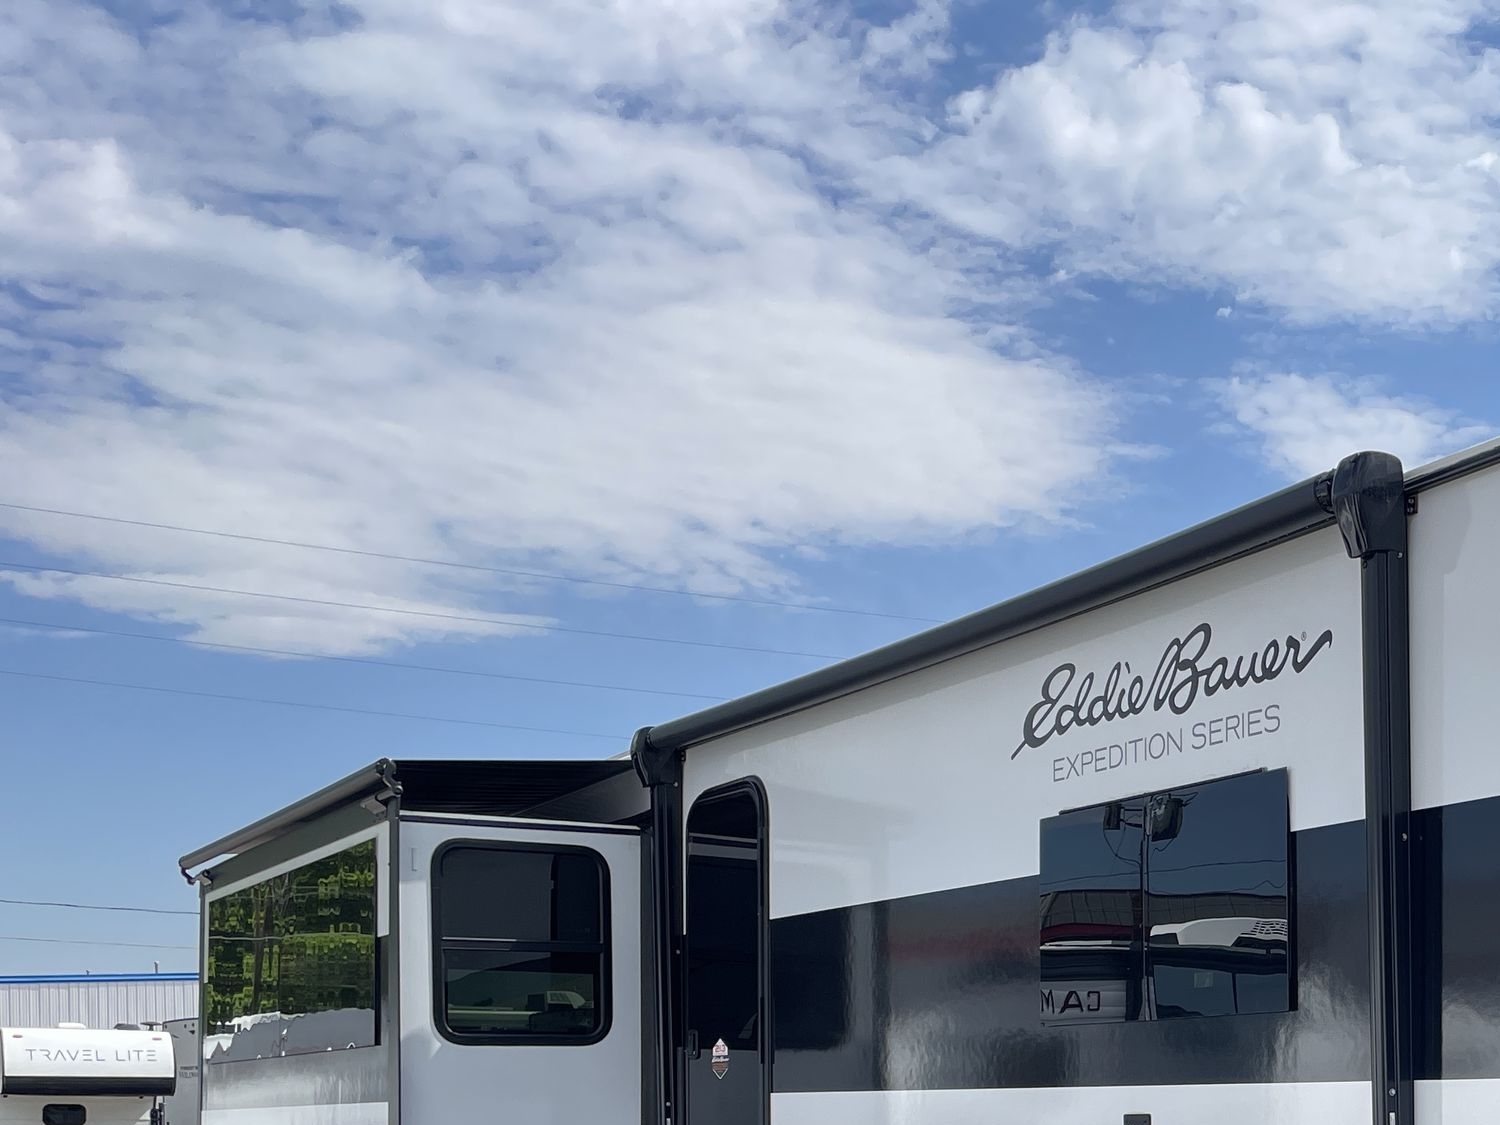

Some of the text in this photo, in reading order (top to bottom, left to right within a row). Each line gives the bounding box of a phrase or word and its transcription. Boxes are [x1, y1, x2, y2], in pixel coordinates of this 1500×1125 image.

[1010, 622, 1333, 760] Eddie Bauer
[1052, 704, 1282, 783] EXPEDITION SERIES
[25, 1049, 158, 1062] TRAVEL LITE
